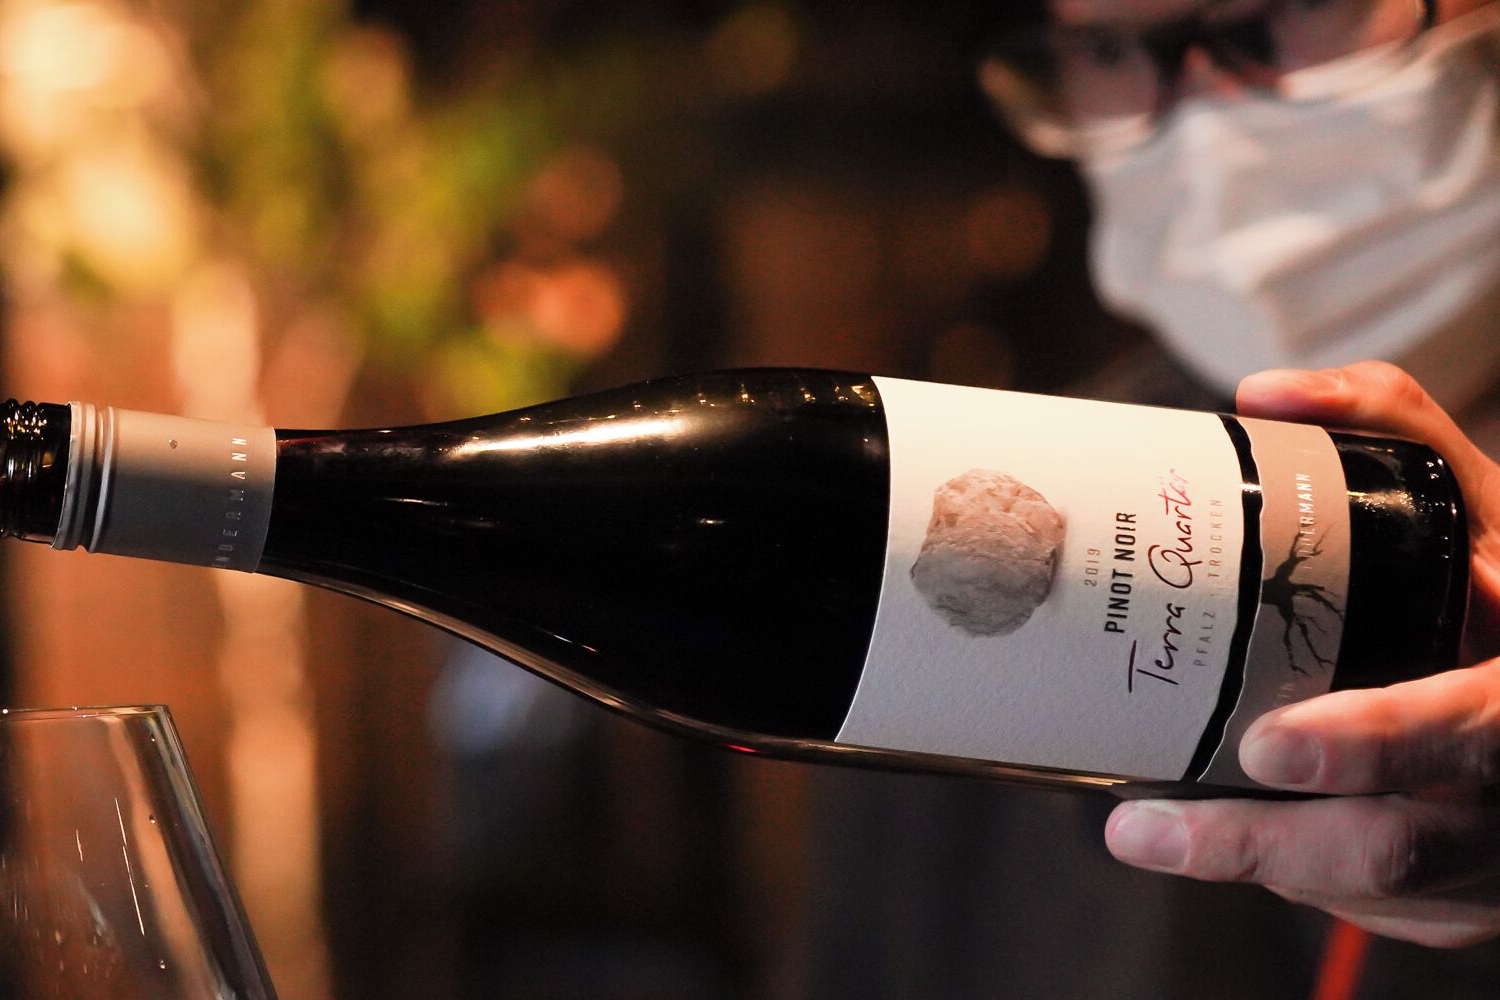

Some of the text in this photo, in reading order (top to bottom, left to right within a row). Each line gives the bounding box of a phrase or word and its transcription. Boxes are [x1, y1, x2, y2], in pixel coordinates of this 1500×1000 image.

[1083, 548, 1101, 588] 2019
[1104, 511, 1137, 634] PINOT NOIR
[1192, 499, 1223, 668] PFALZ TROCKEN
[1128, 603, 1186, 694] Terra
